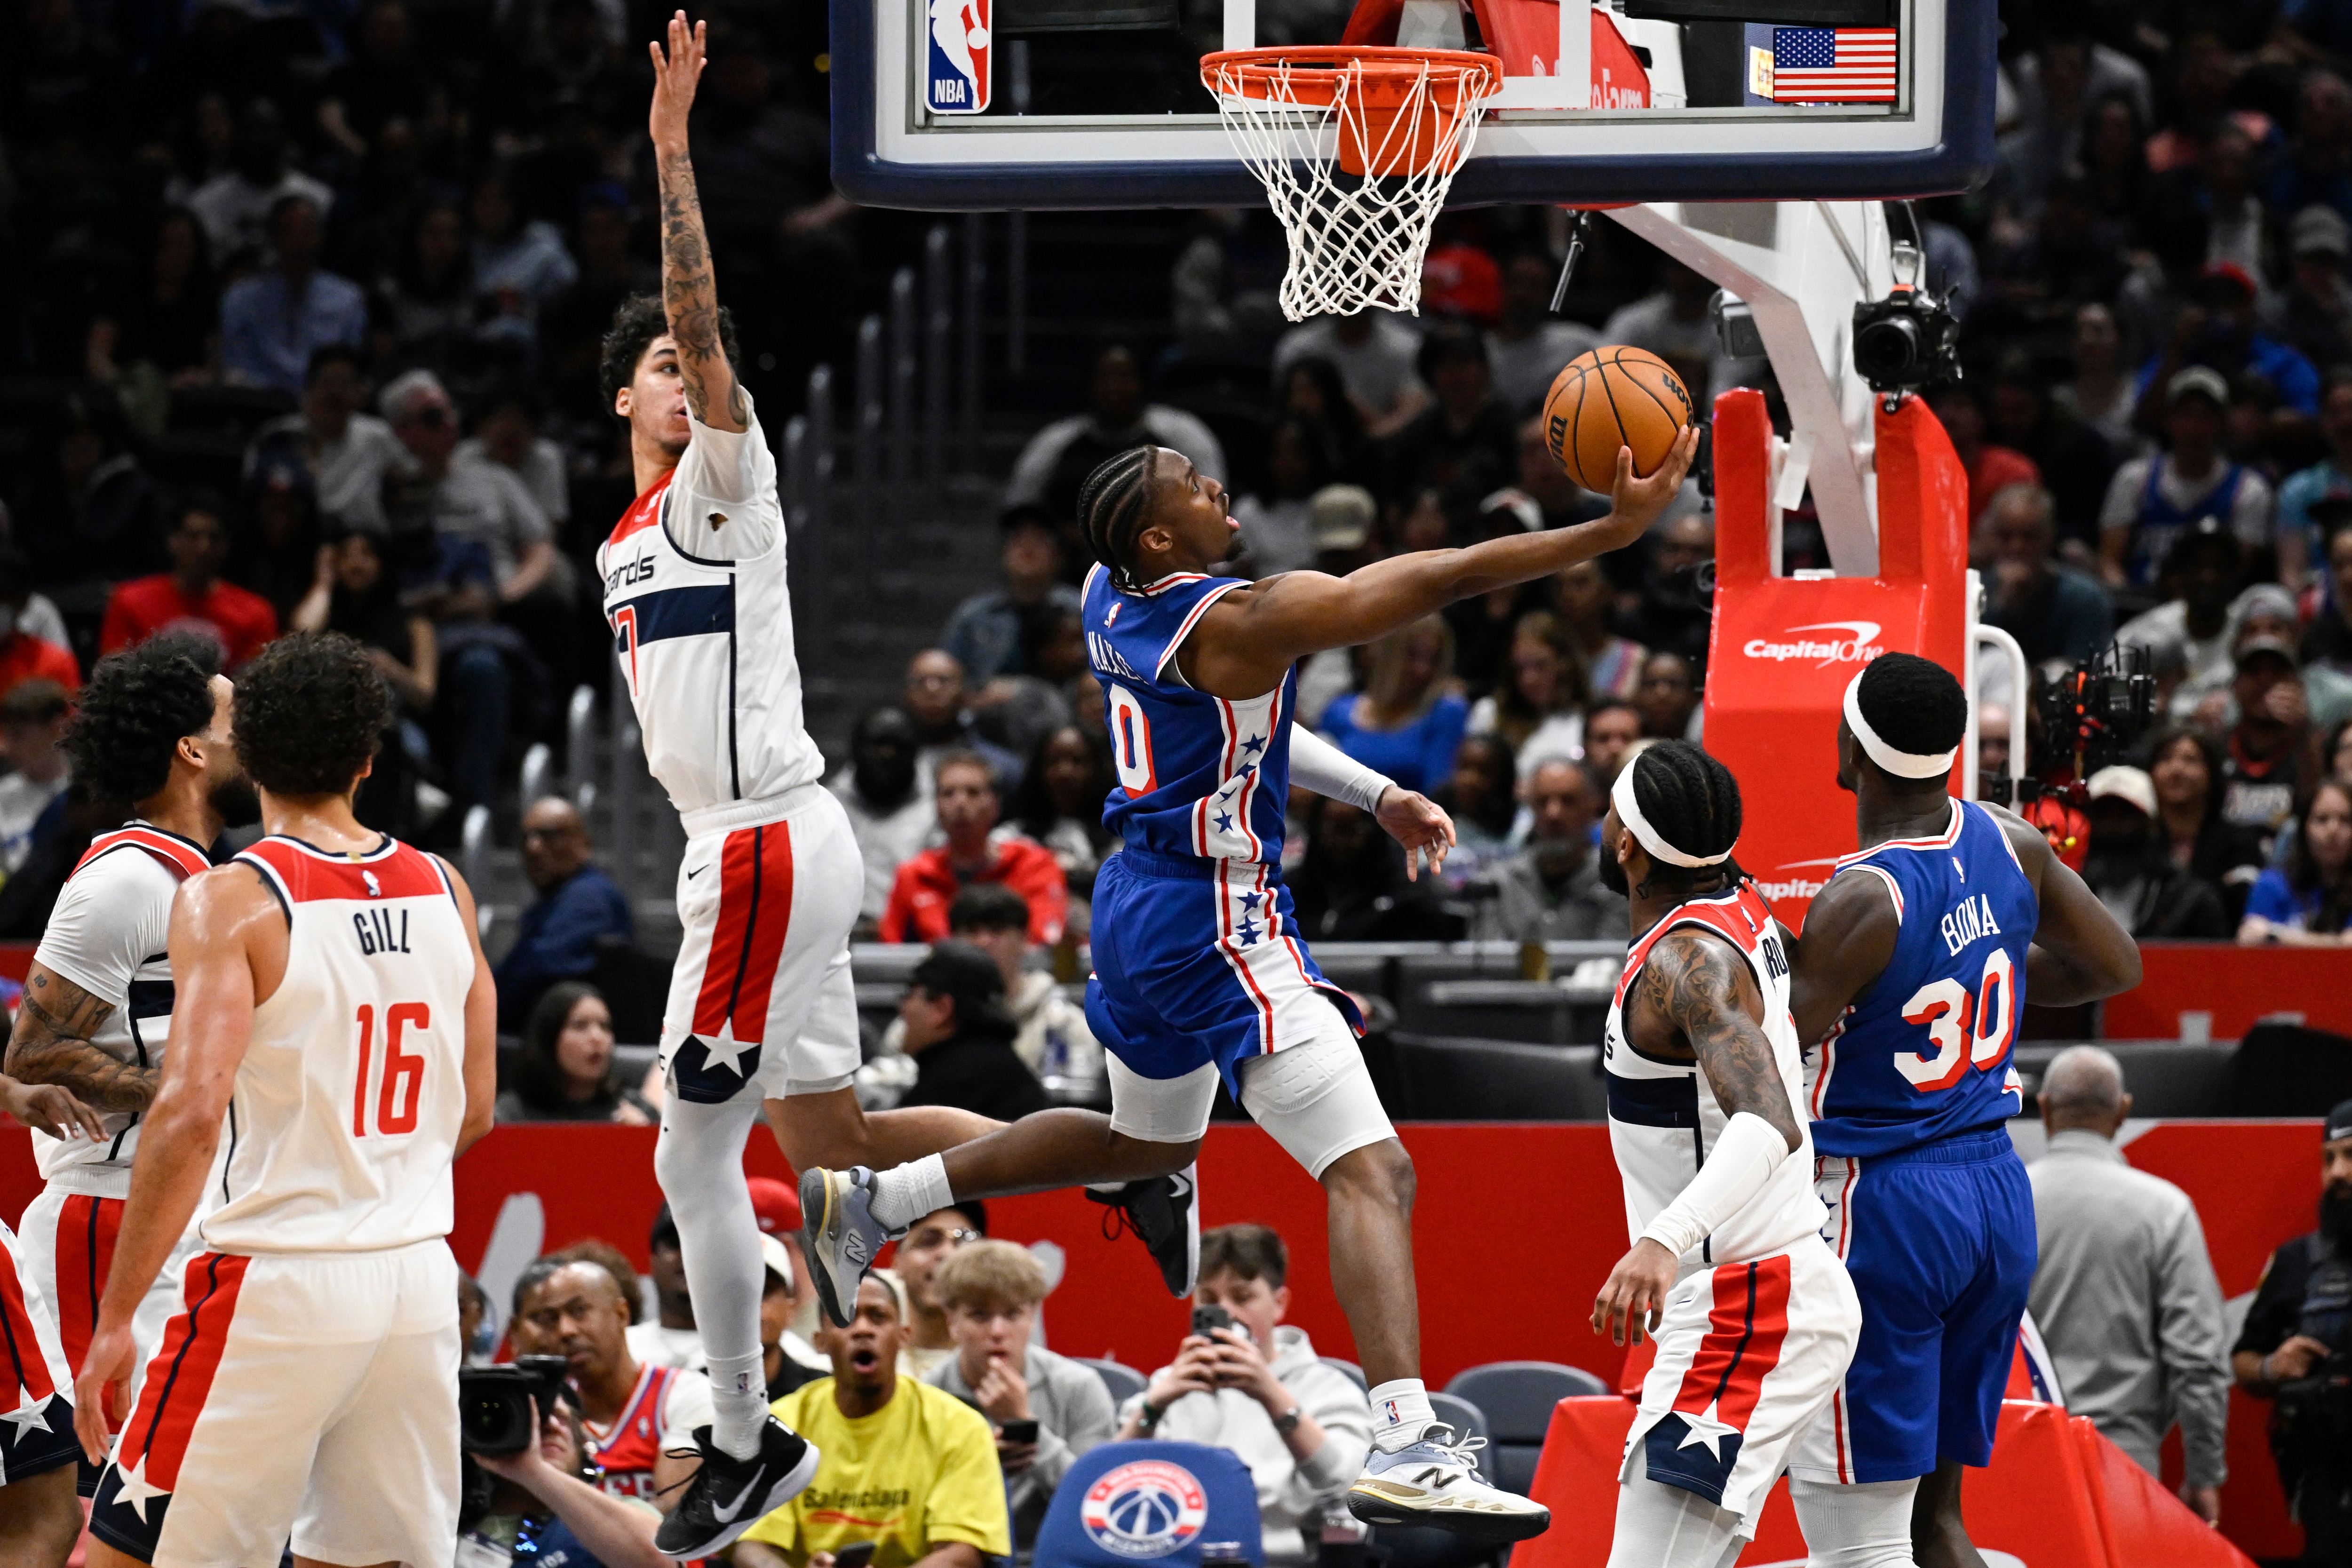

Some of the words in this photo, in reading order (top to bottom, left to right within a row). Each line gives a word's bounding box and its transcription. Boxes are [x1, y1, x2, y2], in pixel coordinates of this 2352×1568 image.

[935, 79, 966, 103] NBA
[1088, 631, 1149, 685] MAXE
[1109, 683, 1158, 800] 0
[1752, 878, 1831, 902] apita
[353, 907, 411, 955] GILL
[1940, 894, 2001, 957] BONA
[1893, 947, 2015, 1093] 30
[353, 1002, 430, 1138] 16
